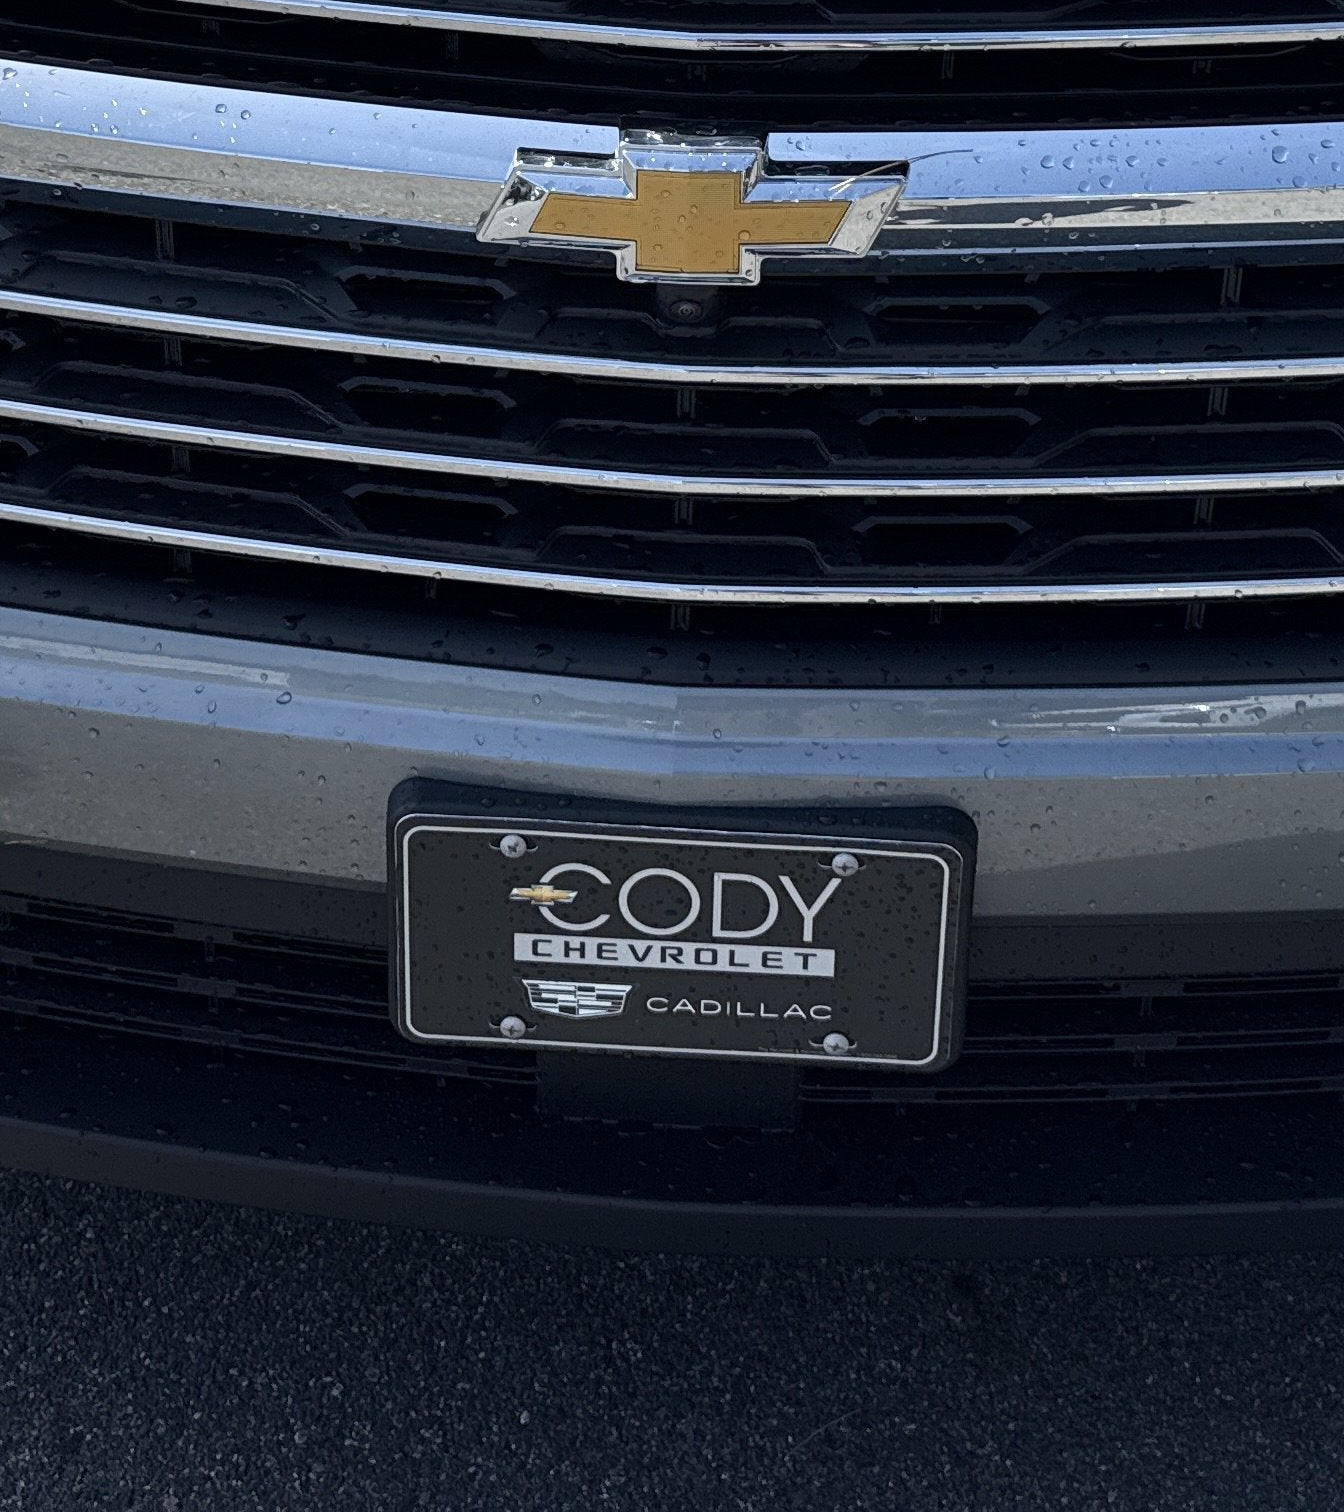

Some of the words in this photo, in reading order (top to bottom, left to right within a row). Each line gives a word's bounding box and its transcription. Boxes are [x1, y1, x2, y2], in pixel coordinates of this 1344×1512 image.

[537, 862, 843, 943] CODY
[531, 937, 818, 972] CHEVROLET
[645, 996, 834, 1021] CADILLAC
